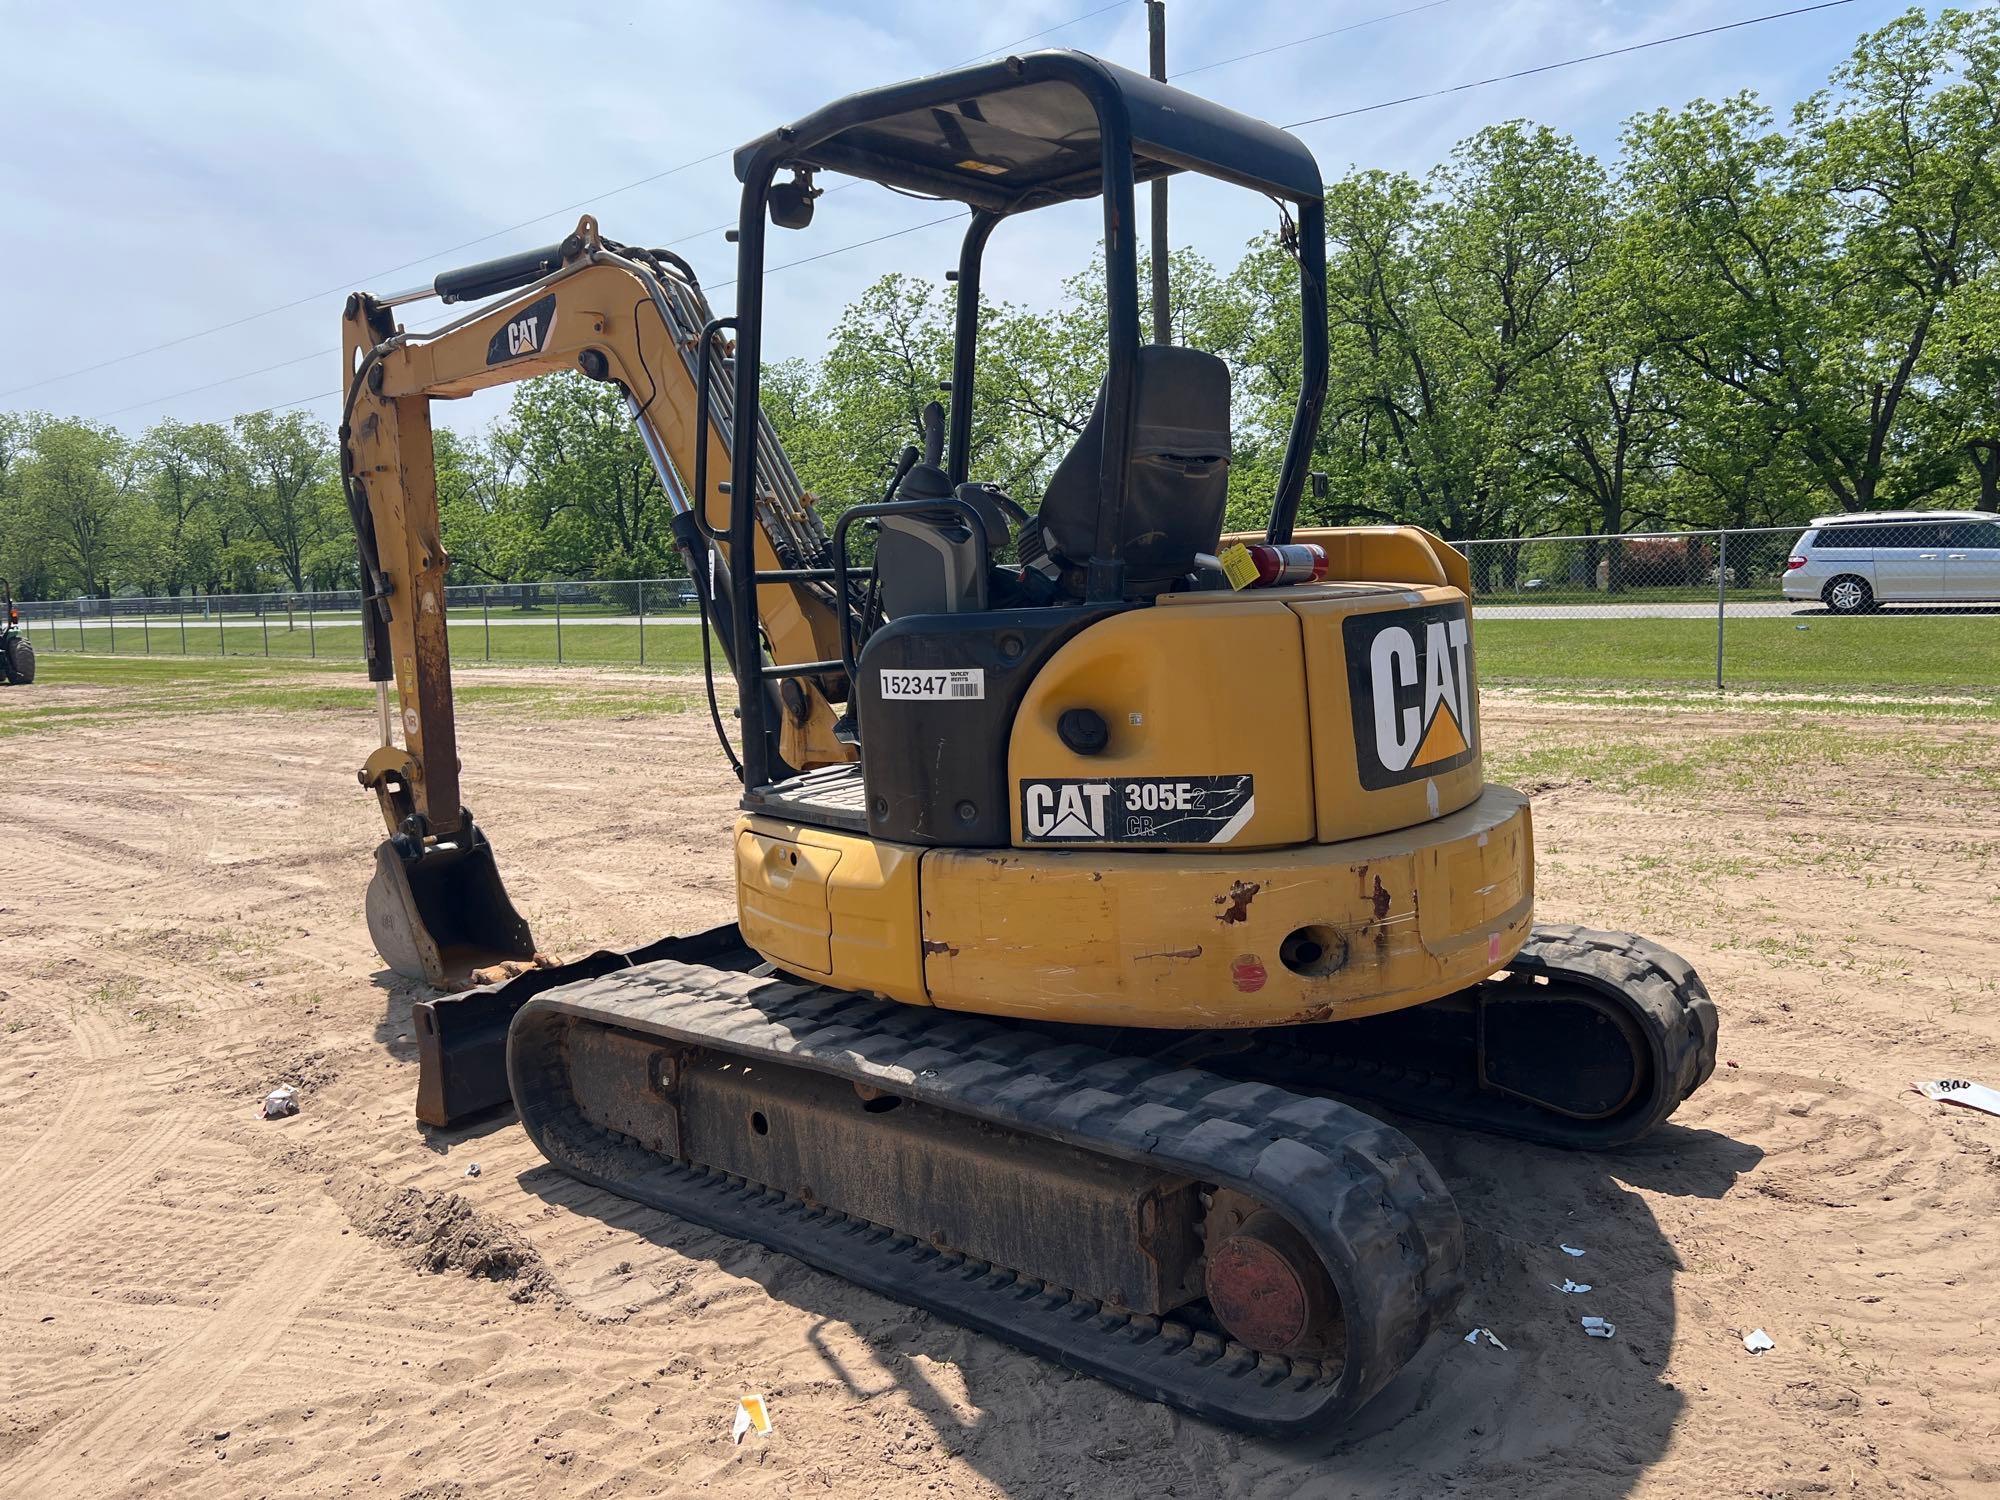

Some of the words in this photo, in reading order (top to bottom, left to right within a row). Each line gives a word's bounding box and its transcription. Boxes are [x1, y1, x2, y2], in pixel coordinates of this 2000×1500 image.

[507, 316, 538, 356] CAT
[882, 676, 947, 695] 152347
[1370, 619, 1472, 772] CAT
[1026, 783, 1111, 837] CAT
[1126, 815, 1155, 836] CR
